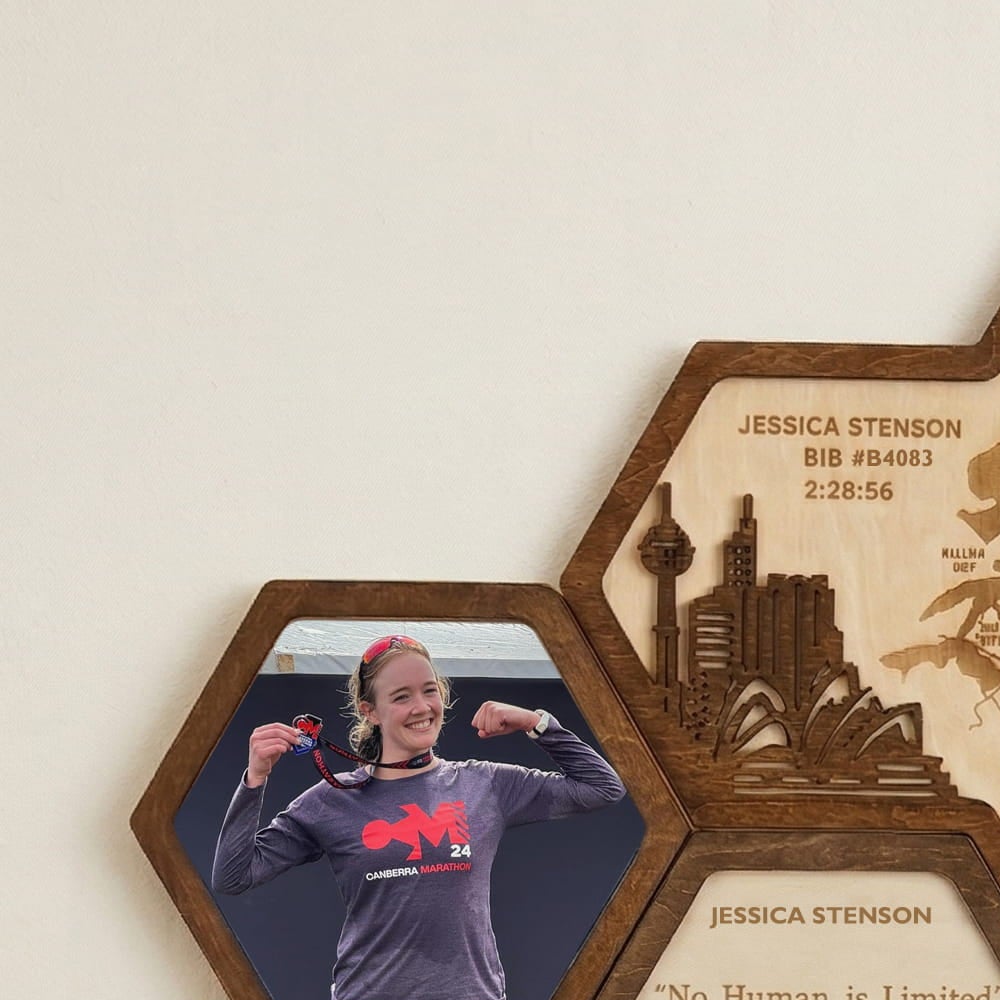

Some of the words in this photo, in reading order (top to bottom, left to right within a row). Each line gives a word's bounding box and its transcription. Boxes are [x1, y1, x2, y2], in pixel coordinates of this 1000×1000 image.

[738, 415, 840, 436] JESSICA
[848, 417, 962, 438] STENSON
[804, 447, 843, 467] BIB
[851, 449, 933, 467] #B4083
[804, 480, 894, 501] 2:28:56
[450, 844, 471, 858] 24
[366, 866, 419, 881] CANBERRA
[420, 862, 472, 874] MARATHON
[710, 906, 805, 928] JESSICA
[813, 906, 932, 925] STENSON
